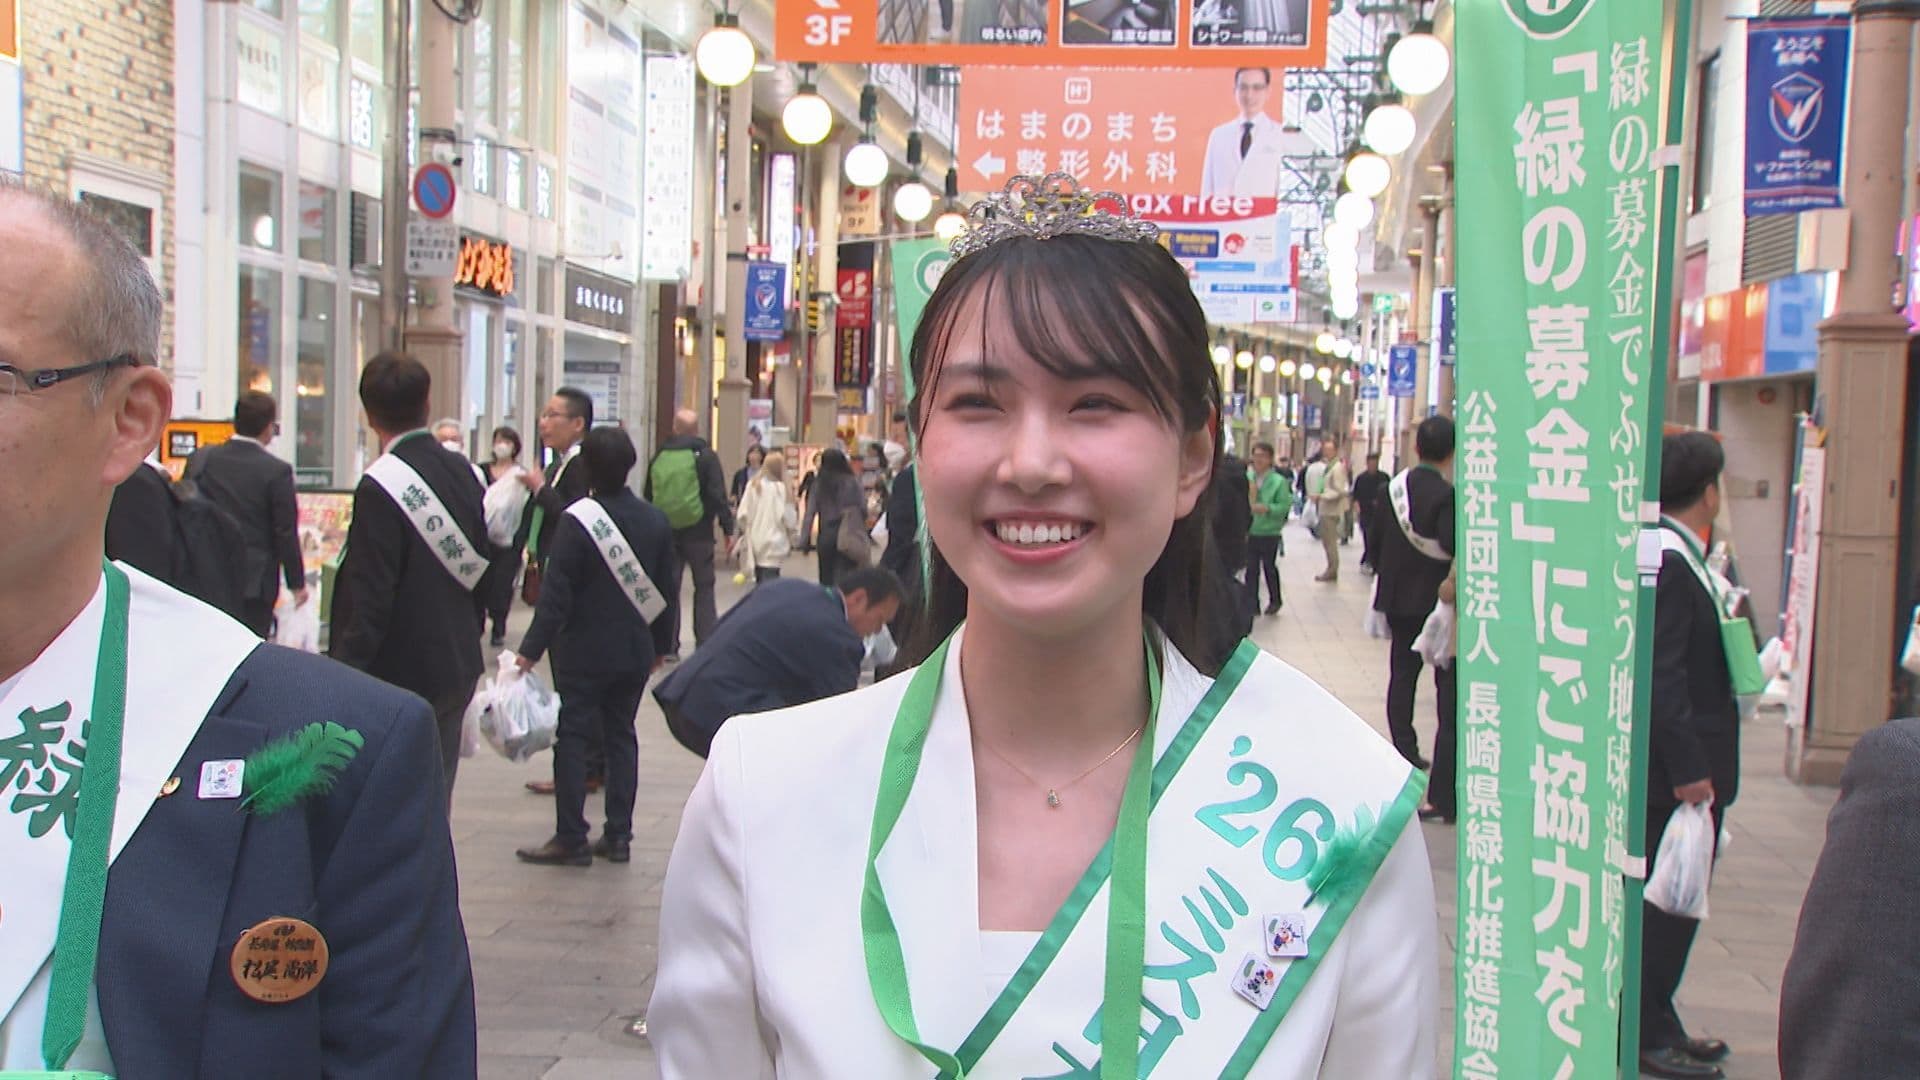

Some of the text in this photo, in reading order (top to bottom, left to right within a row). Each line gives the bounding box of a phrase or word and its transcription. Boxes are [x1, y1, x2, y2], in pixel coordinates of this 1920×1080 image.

[804, 15, 853, 47] 3F
[976, 108, 1178, 144] はまのまち
[1016, 148, 1178, 184] 整形外科
[1463, 389, 1501, 666] 公益社団法人
